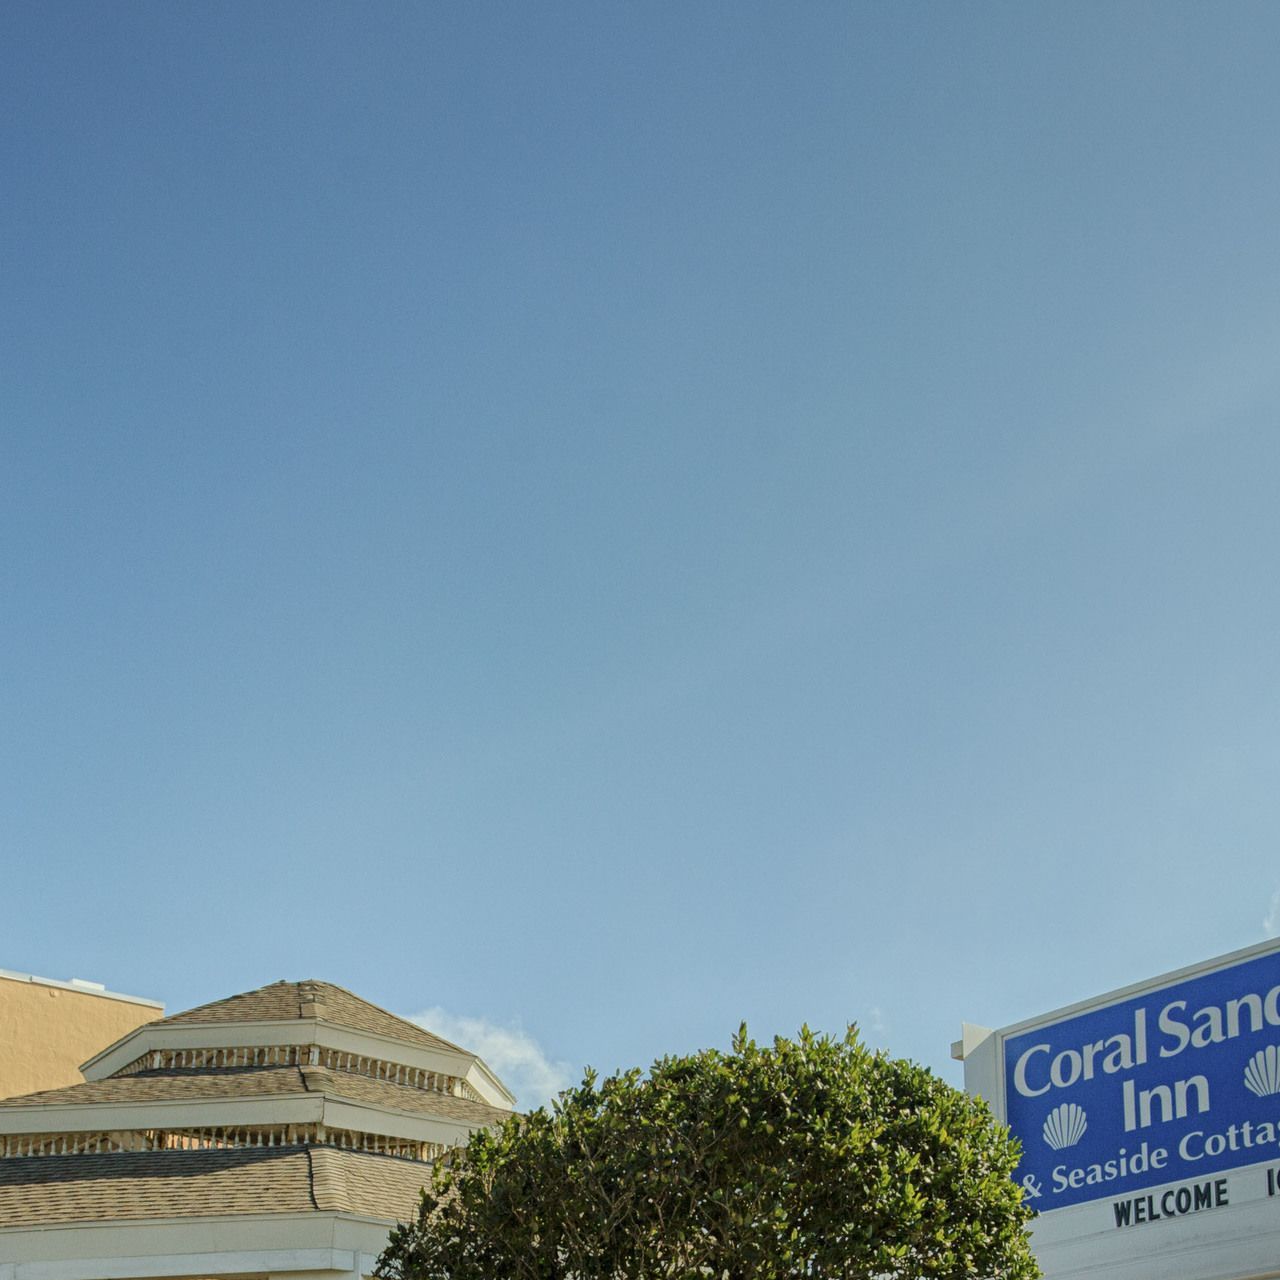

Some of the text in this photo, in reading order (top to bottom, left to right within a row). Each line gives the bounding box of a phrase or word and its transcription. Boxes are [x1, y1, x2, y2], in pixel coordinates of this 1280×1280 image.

[1013, 1008, 1147, 1098] Coral
[1123, 1075, 1210, 1132] Inn
[1023, 1174, 1043, 1200] &
[1052, 1142, 1168, 1193] Seaside
[1114, 1178, 1229, 1227] WELCOME
